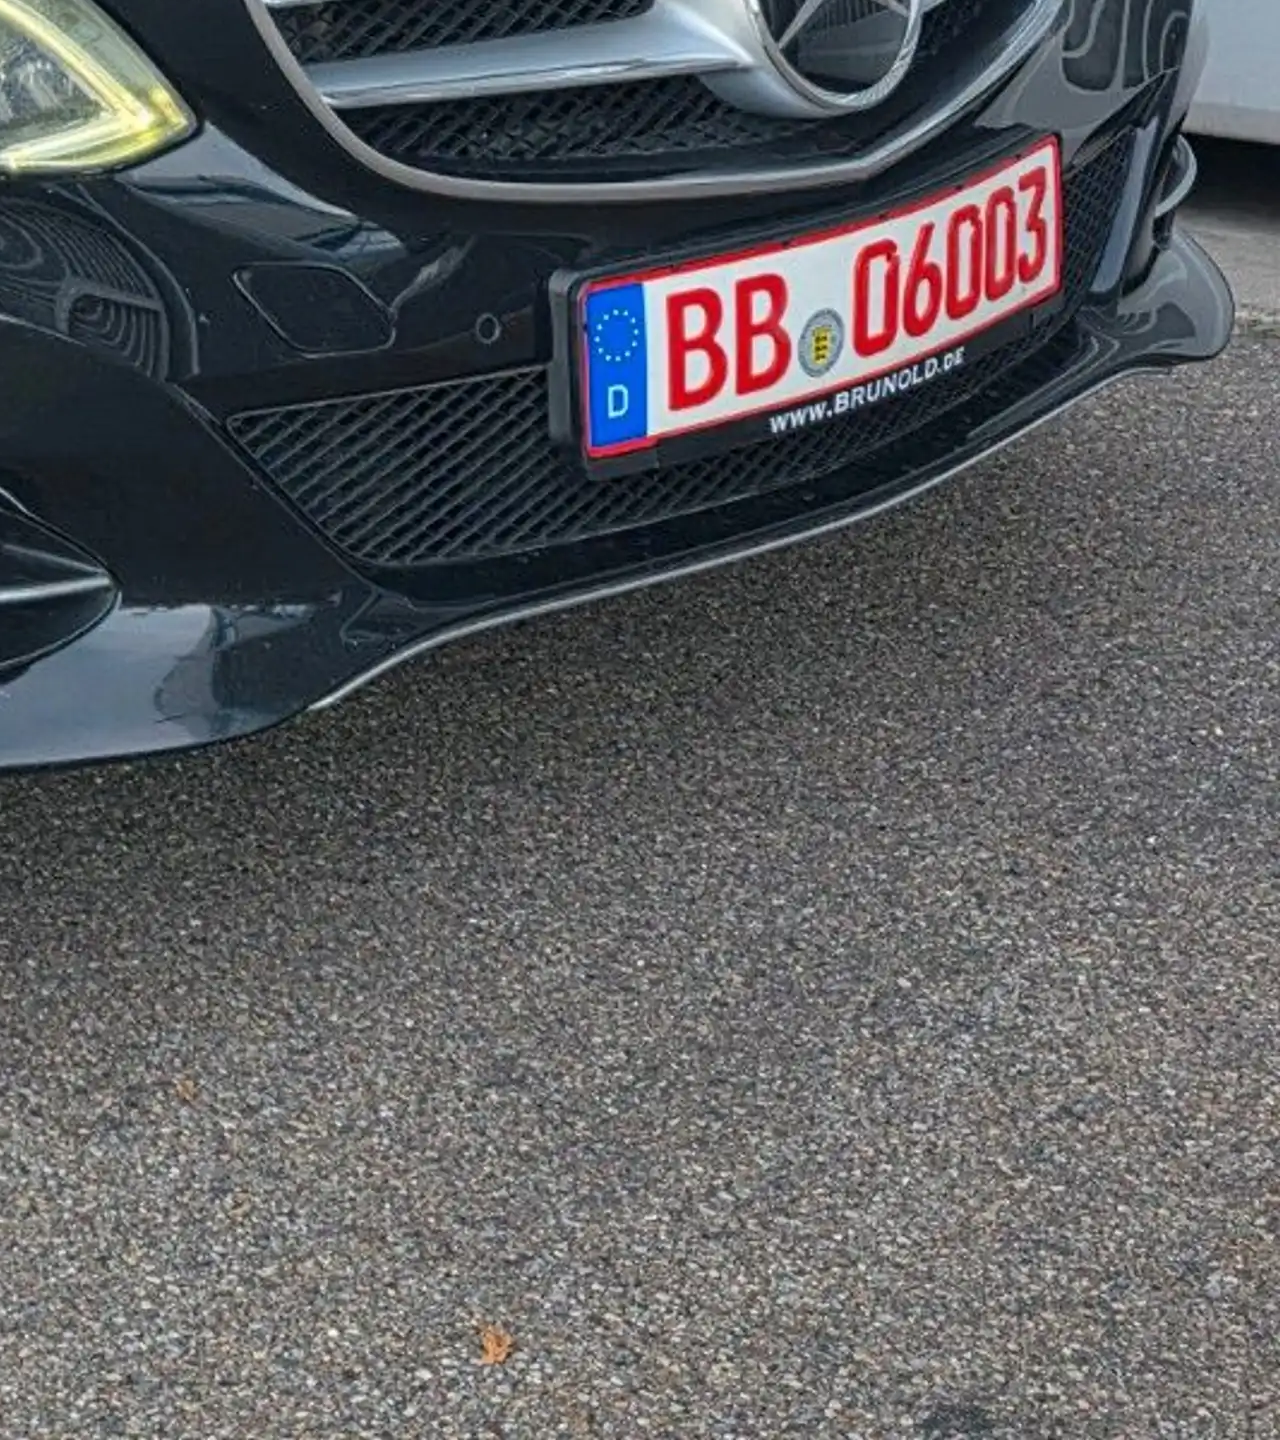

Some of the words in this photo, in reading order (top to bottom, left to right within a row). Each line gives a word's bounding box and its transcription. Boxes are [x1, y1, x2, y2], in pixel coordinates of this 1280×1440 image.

[666, 273, 793, 412] BB
[852, 166, 1046, 358] 06003
[607, 384, 629, 418] D
